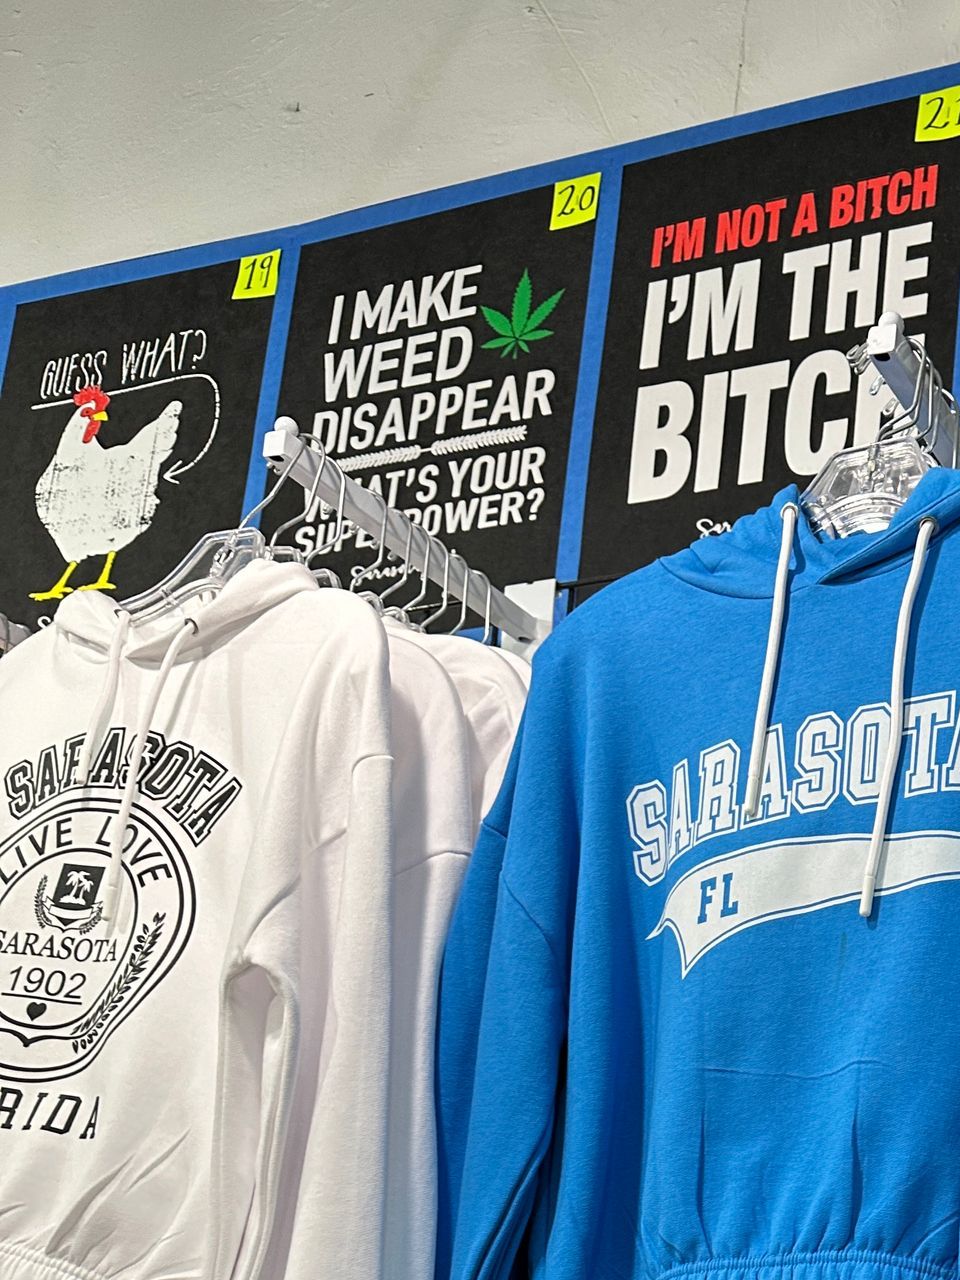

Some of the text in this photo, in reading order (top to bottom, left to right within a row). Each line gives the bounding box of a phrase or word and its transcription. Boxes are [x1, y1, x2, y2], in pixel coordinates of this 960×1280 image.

[557, 184, 595, 218] 20
[651, 164, 938, 268] I'M NOT A BITCH
[244, 255, 272, 290] 19
[328, 265, 483, 345] I MAKE
[639, 221, 933, 370] I'M THE
[41, 330, 206, 399] GUESS WHAT?
[323, 327, 473, 402] WEED
[311, 369, 556, 454] DISAPPEAR
[448, 446, 546, 497] YOUR
[294, 487, 546, 556] SUPPOWER?
[0, 817, 72, 885] LIVE
[697, 872, 739, 925] FL
[7, 966, 87, 999] 1902
